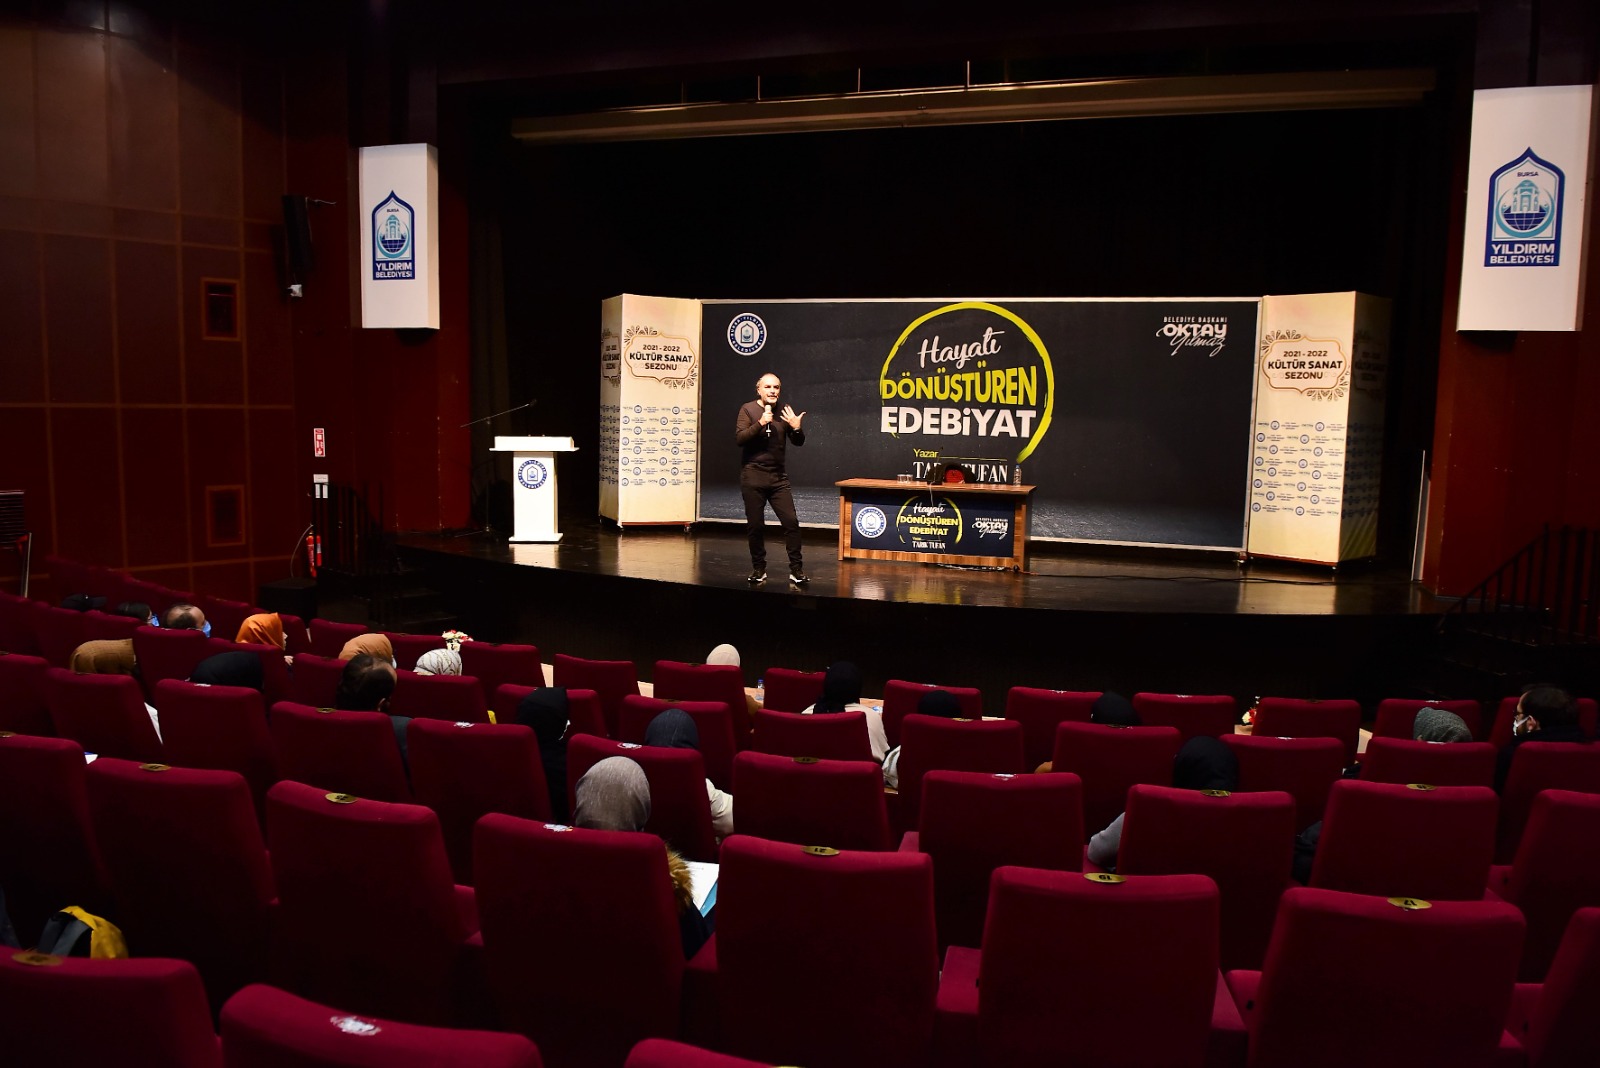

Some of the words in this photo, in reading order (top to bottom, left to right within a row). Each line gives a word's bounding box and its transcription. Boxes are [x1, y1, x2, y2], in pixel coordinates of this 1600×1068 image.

[1492, 244, 1555, 254] YILDIRIM
[376, 262, 412, 271] YILDIRIM
[1162, 324, 1227, 338] OKTAY
[630, 352, 662, 361] KÜLTÜR
[645, 362, 677, 370] SEZONU
[1268, 359, 1306, 369] KÜLTÜR
[1308, 360, 1342, 368] SANAT
[1285, 372, 1323, 380] SEZONU
[882, 360, 1037, 406] DÖNÜŞTÜREN
[913, 448, 939, 458] Yazar
